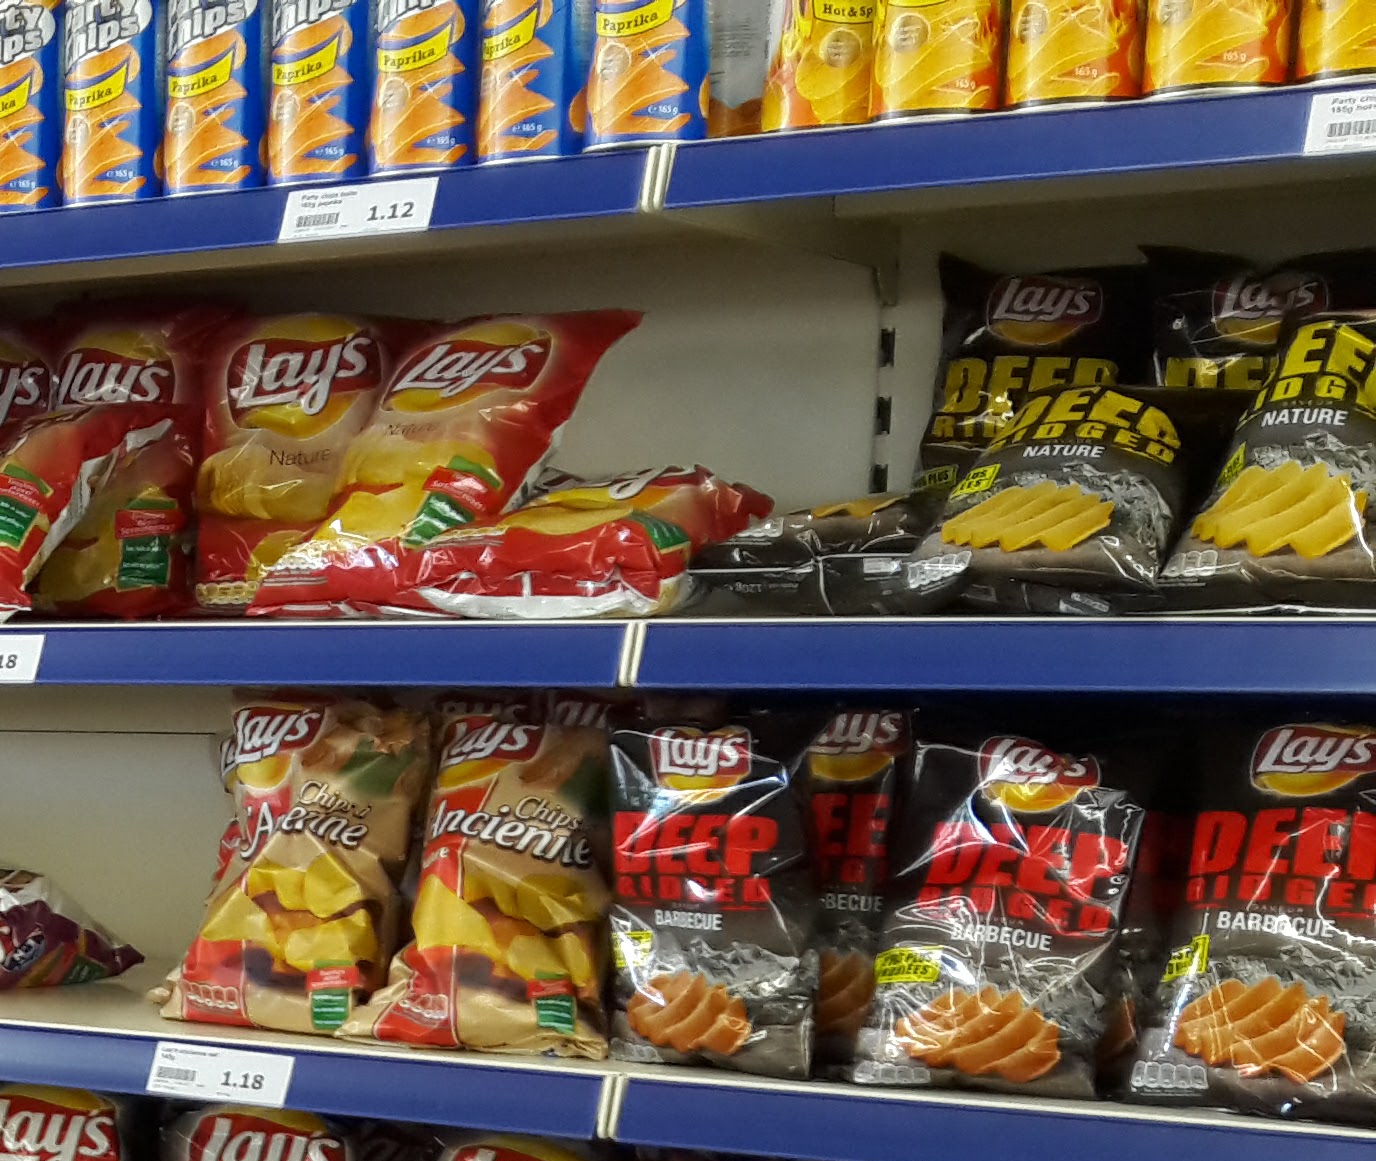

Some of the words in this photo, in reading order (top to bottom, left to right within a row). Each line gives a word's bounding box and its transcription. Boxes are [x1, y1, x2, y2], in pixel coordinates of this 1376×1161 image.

[601, 11, 660, 32] Paprika
[382, 46, 436, 68] Paprika
[171, 73, 218, 93] Paprika
[275, 60, 323, 81] Paprika
[366, 200, 415, 222] 1.12
[992, 278, 1097, 322] Lay's
[234, 331, 376, 415] Lay's
[391, 340, 546, 394] Lay's
[1260, 407, 1349, 428] NATURE
[270, 445, 332, 468] Nature
[1023, 443, 1106, 458] NATURE
[235, 707, 322, 763] Lay's
[658, 729, 748, 776] Lay's
[298, 780, 348, 812] Chips
[515, 796, 583, 830] Chips
[614, 811, 779, 875] DEEP
[923, 820, 1129, 902] DEEP
[822, 893, 884, 913] BECUE
[654, 909, 724, 931] BARBECUE
[1216, 909, 1337, 939] BARBECUE
[950, 920, 1053, 951] BARBECUE
[220, 1069, 265, 1091] 1.18
